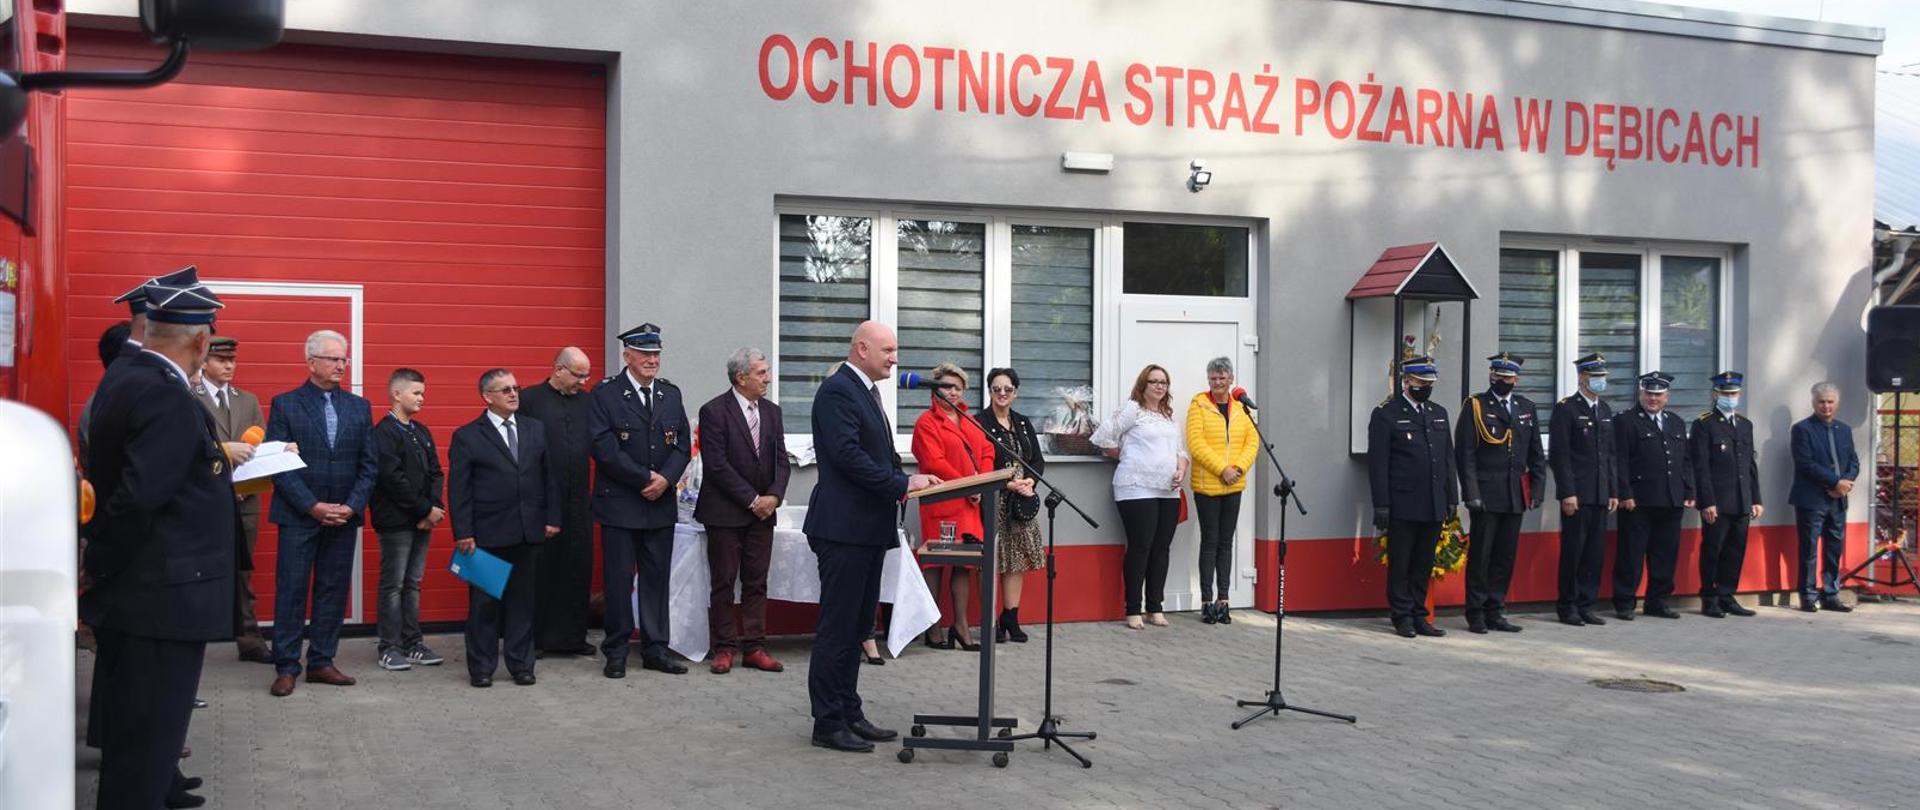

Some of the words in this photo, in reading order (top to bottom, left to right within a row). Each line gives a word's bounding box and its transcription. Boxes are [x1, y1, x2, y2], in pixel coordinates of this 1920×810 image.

[758, 34, 1111, 122] OCHOTNICZA
[1124, 63, 1279, 134] STRAŻ
[1295, 73, 1505, 152] POŻARNA
[1515, 97, 1553, 154] W
[1565, 102, 1760, 170] DĘBICACH
